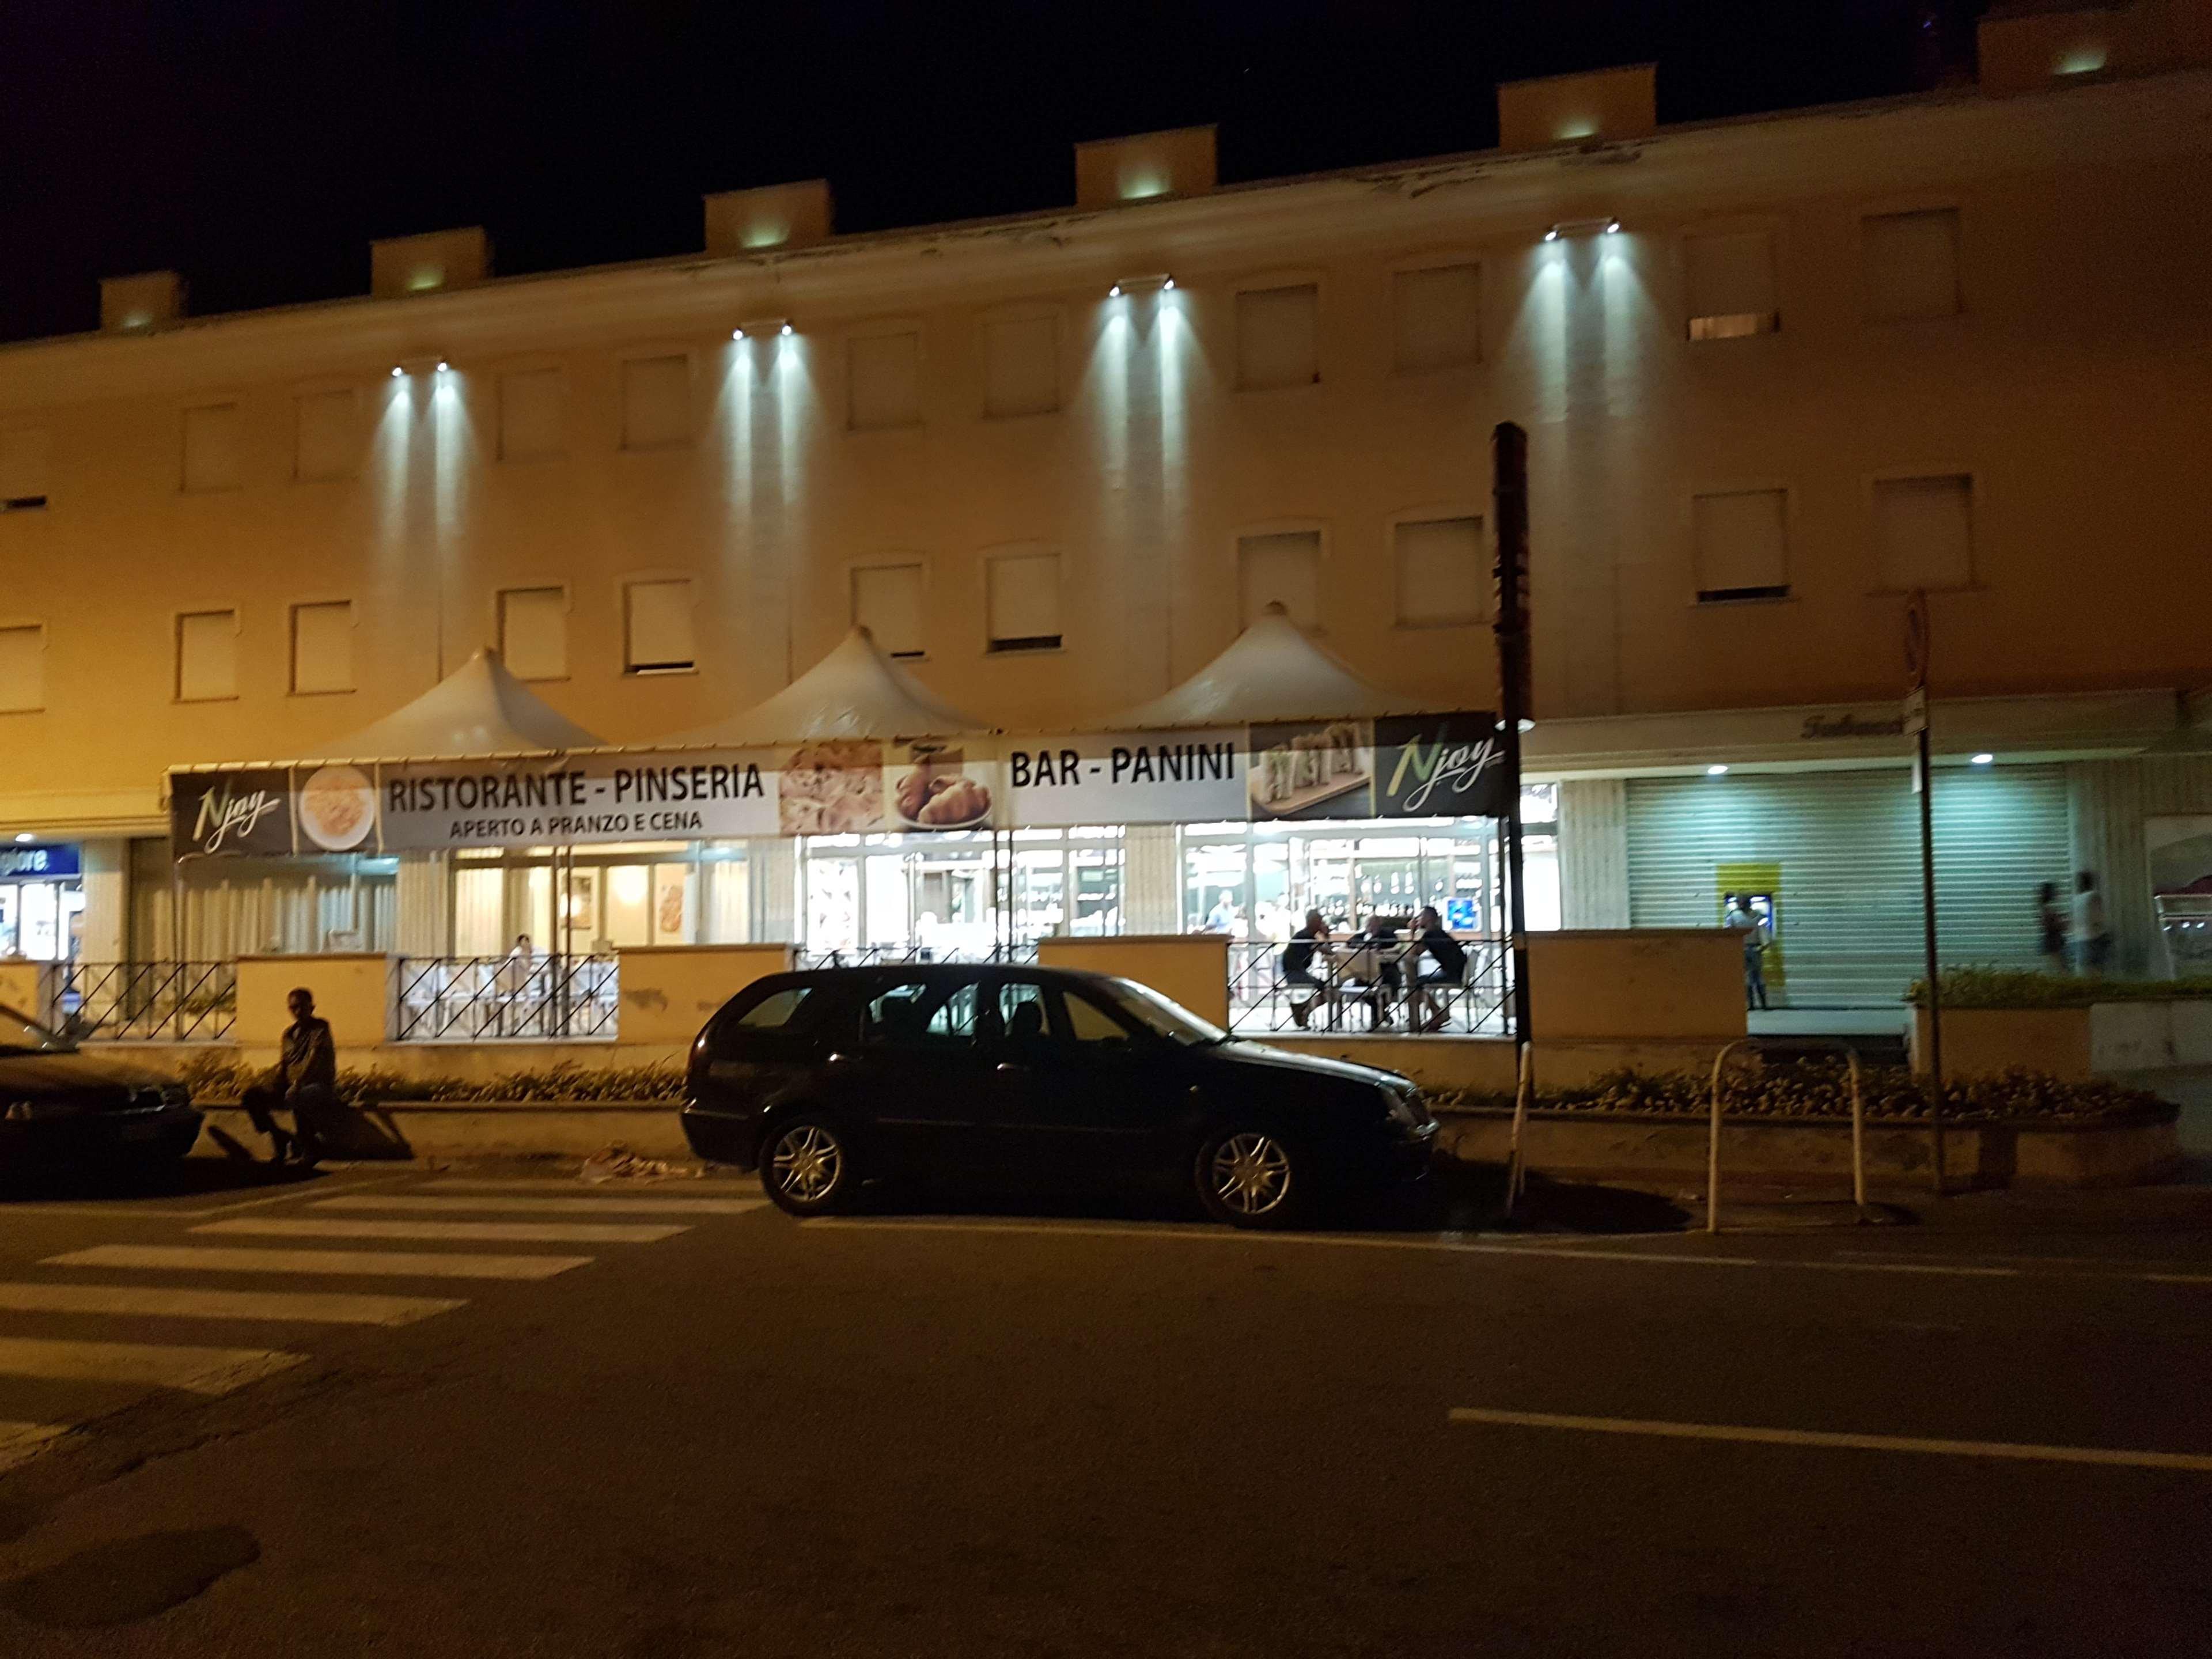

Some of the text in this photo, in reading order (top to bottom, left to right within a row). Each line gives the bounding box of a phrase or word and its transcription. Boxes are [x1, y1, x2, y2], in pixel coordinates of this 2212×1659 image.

[390, 771, 586, 812] RISTORANTE
[615, 763, 765, 804] PINSERIA
[1011, 749, 1080, 788] BAR
[1112, 741, 1234, 783] PANINI
[1386, 722, 1507, 812] Njoy
[450, 810, 702, 839] APERTO A PRANZO E CENA
